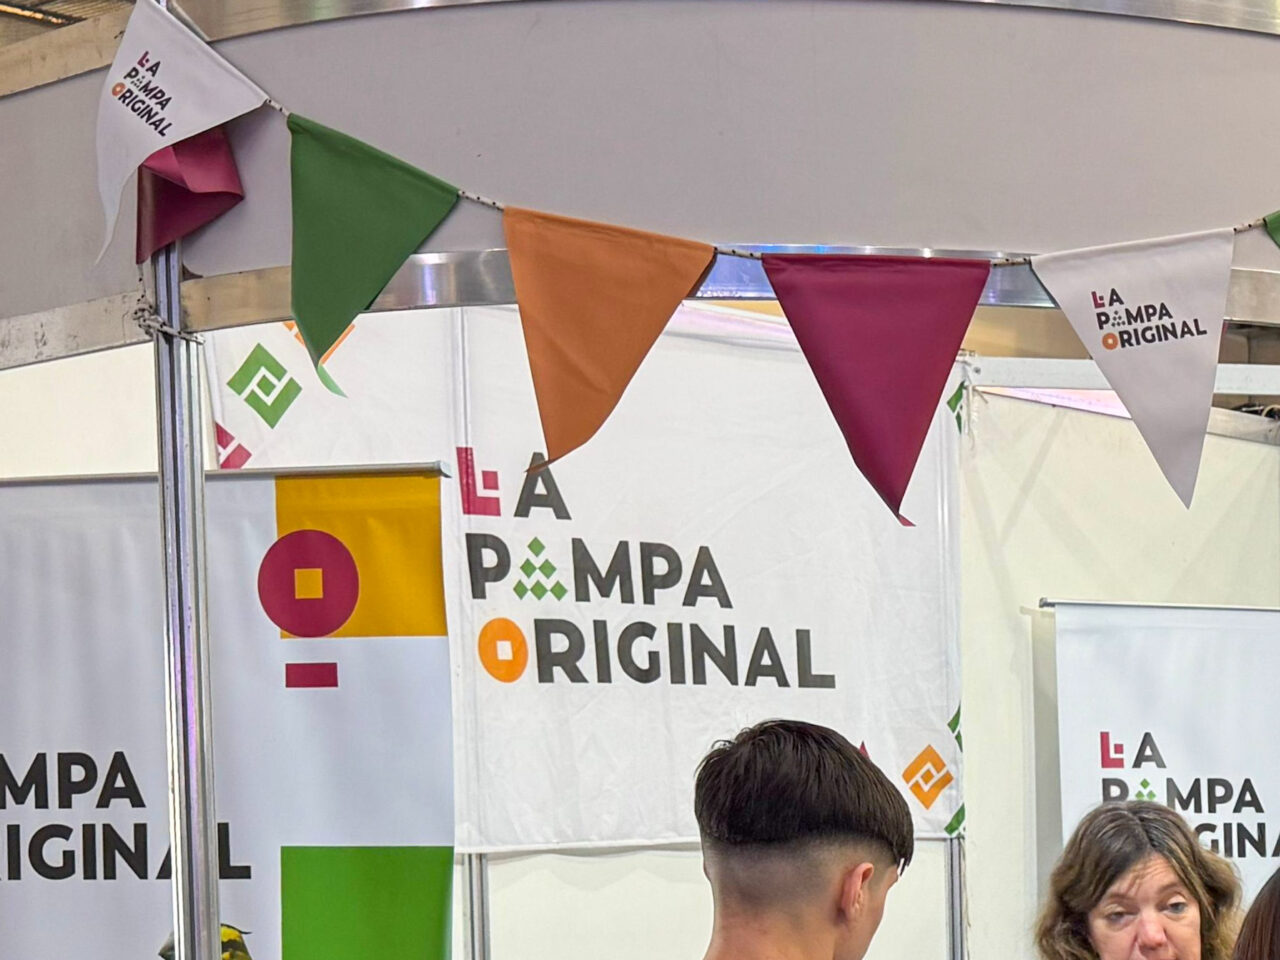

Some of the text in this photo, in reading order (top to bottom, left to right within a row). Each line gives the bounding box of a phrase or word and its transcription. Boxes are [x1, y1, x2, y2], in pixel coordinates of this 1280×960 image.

[123, 66, 173, 111] PAMPA
[136, 50, 162, 78] LA
[111, 81, 173, 138] ORIGINAL
[1091, 287, 1125, 309] LA
[1096, 302, 1174, 331] PAMPA
[1101, 318, 1208, 351] ORIGINAL
[456, 447, 572, 520] LA
[465, 532, 734, 609] PAMPA
[478, 617, 837, 689] ORIGINAL
[1100, 731, 1168, 769] LA
[0, 750, 147, 810] MPA
[0, 821, 252, 881] IGINL
